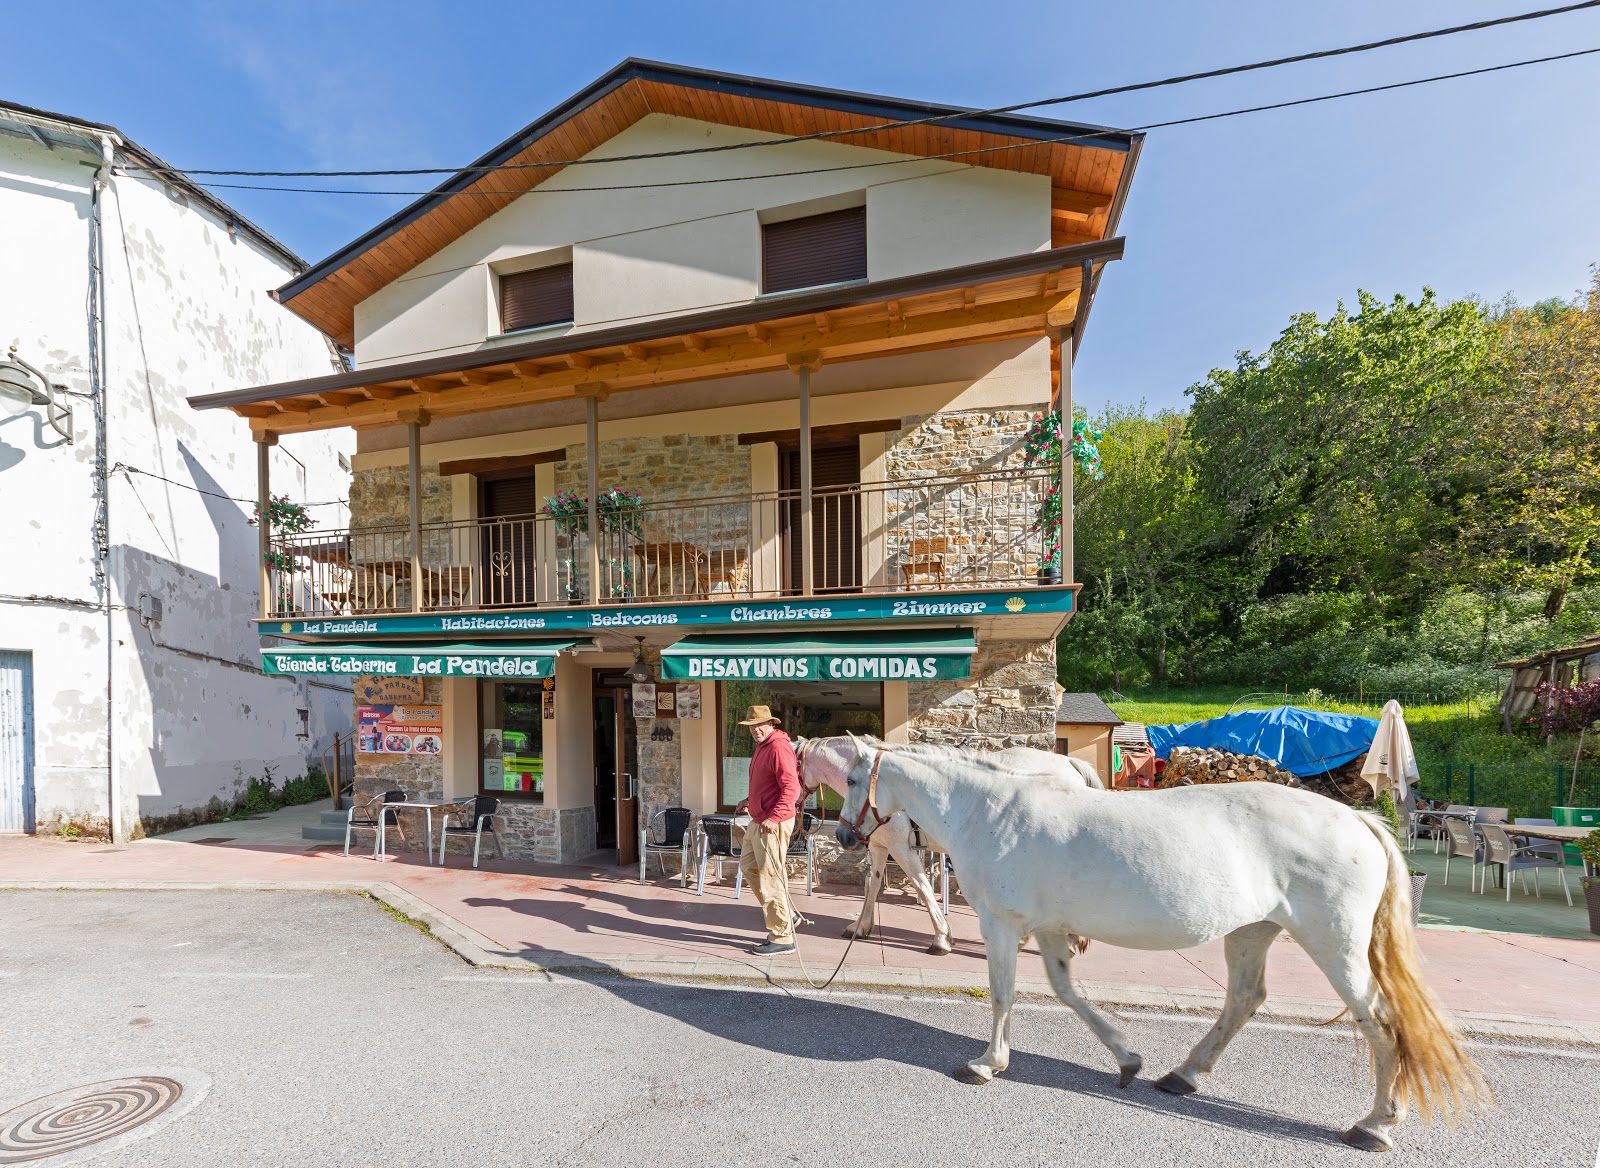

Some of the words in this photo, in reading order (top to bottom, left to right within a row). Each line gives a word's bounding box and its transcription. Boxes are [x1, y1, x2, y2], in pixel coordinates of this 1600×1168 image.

[303, 621, 320, 633] La
[323, 620, 377, 633] Pandela
[441, 616, 545, 630] Habitaciones
[591, 612, 678, 626] Bedrooms
[730, 605, 832, 621] Chambres
[892, 600, 986, 615] Zimmer
[412, 656, 441, 674] La
[446, 656, 539, 676] Pandela
[689, 658, 808, 677] DESAYUNOS
[829, 657, 937, 678] COMIDAS
